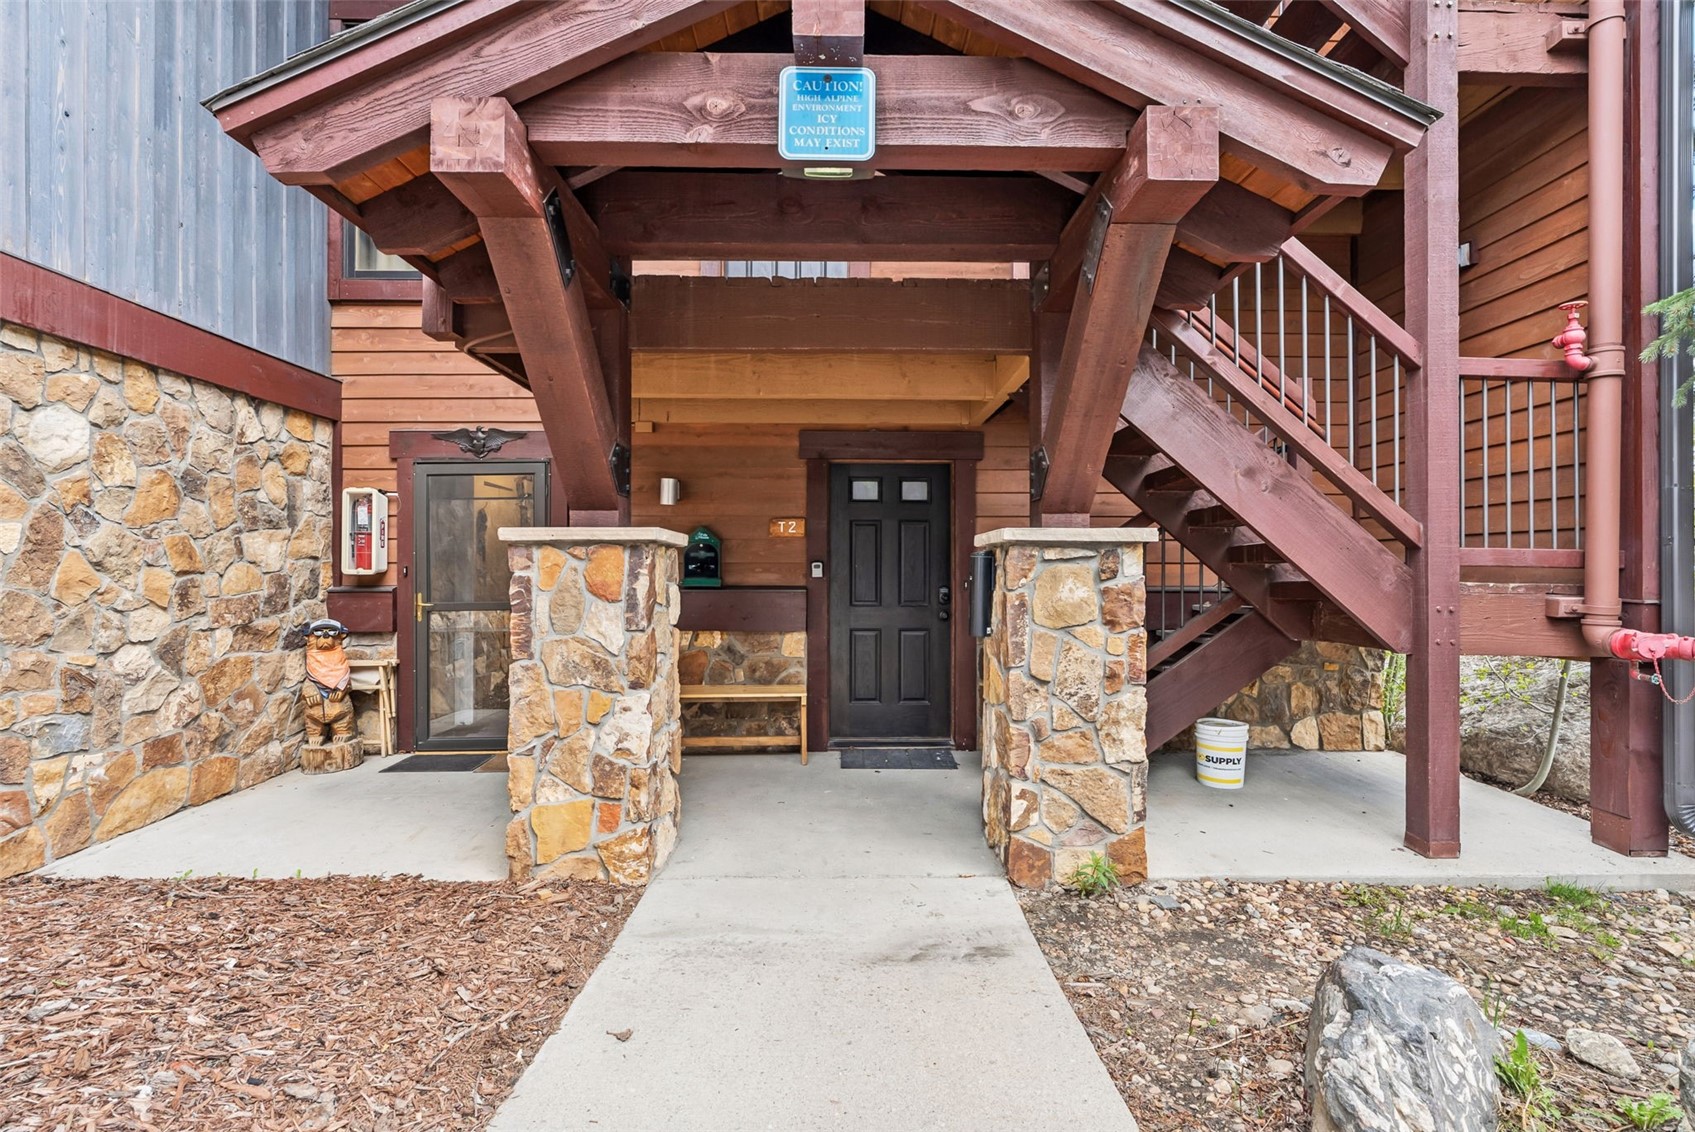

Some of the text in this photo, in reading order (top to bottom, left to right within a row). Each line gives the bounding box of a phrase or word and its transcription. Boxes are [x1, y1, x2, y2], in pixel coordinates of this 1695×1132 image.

[792, 80, 863, 92] CAUTION!
[792, 104, 863, 112] ENVIRONMENT
[817, 114, 837, 123] ICY
[789, 126, 865, 136] CONDITIONS
[794, 138, 860, 148] MAY EXIST
[1205, 754, 1242, 765] SUPPLY
